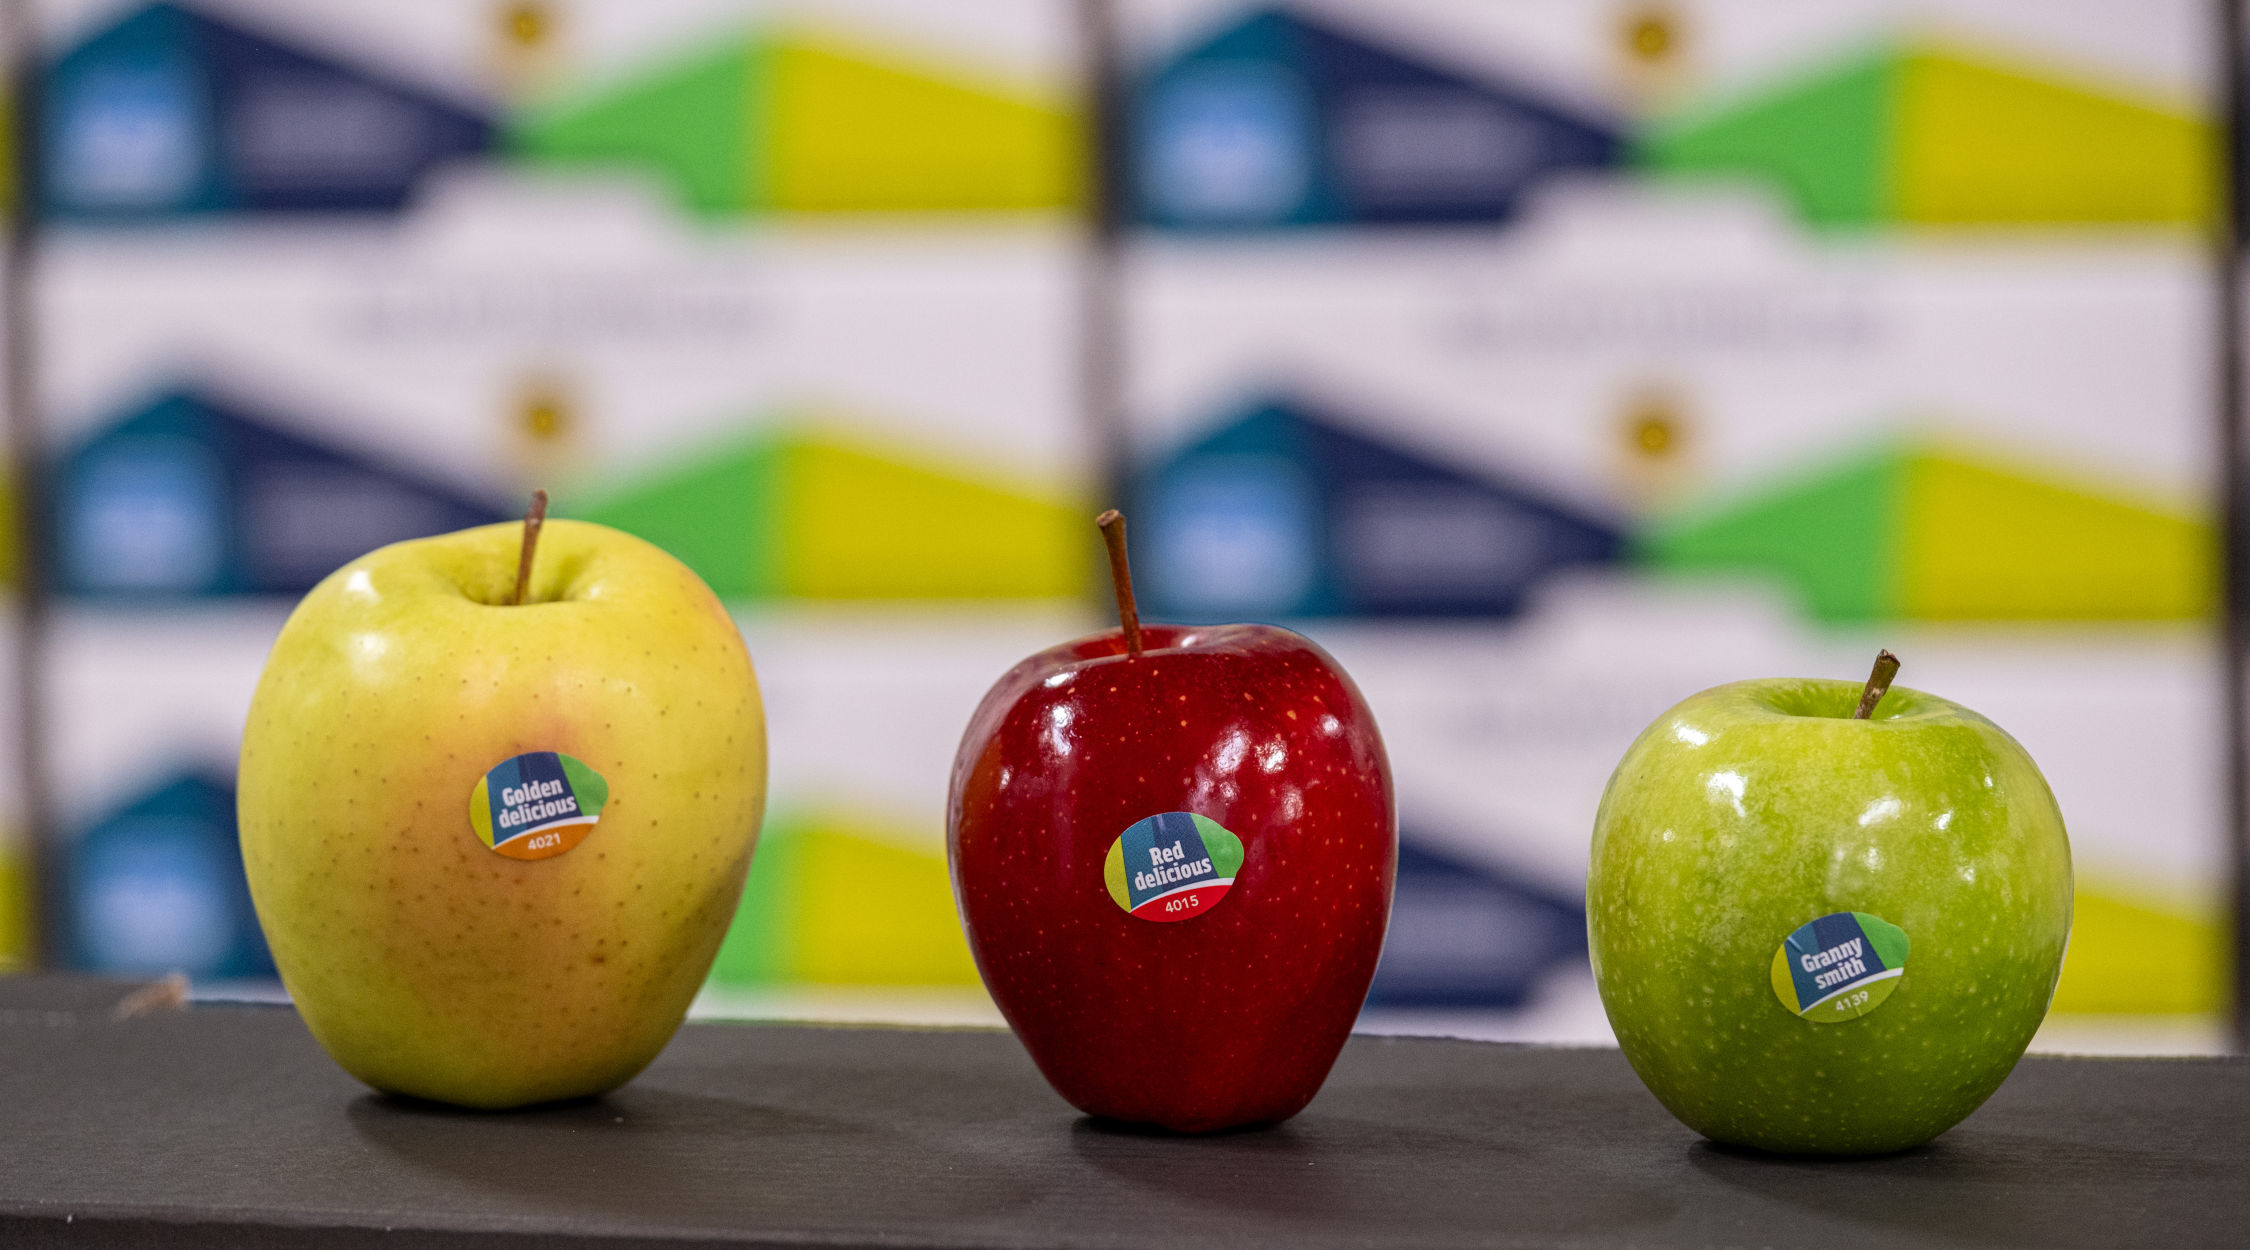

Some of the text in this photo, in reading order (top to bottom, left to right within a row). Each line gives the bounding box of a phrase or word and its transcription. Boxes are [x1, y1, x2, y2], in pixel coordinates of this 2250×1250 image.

[502, 779, 564, 807] Golden
[498, 796, 577, 828] delicious
[528, 832, 561, 850] 4021
[1148, 840, 1185, 866] Red
[1134, 857, 1212, 891] delicious
[1165, 895, 1199, 913] 4015
[1801, 937, 1863, 973] Granny
[1814, 957, 1867, 989] smith
[1835, 990, 1869, 1011] 4139
